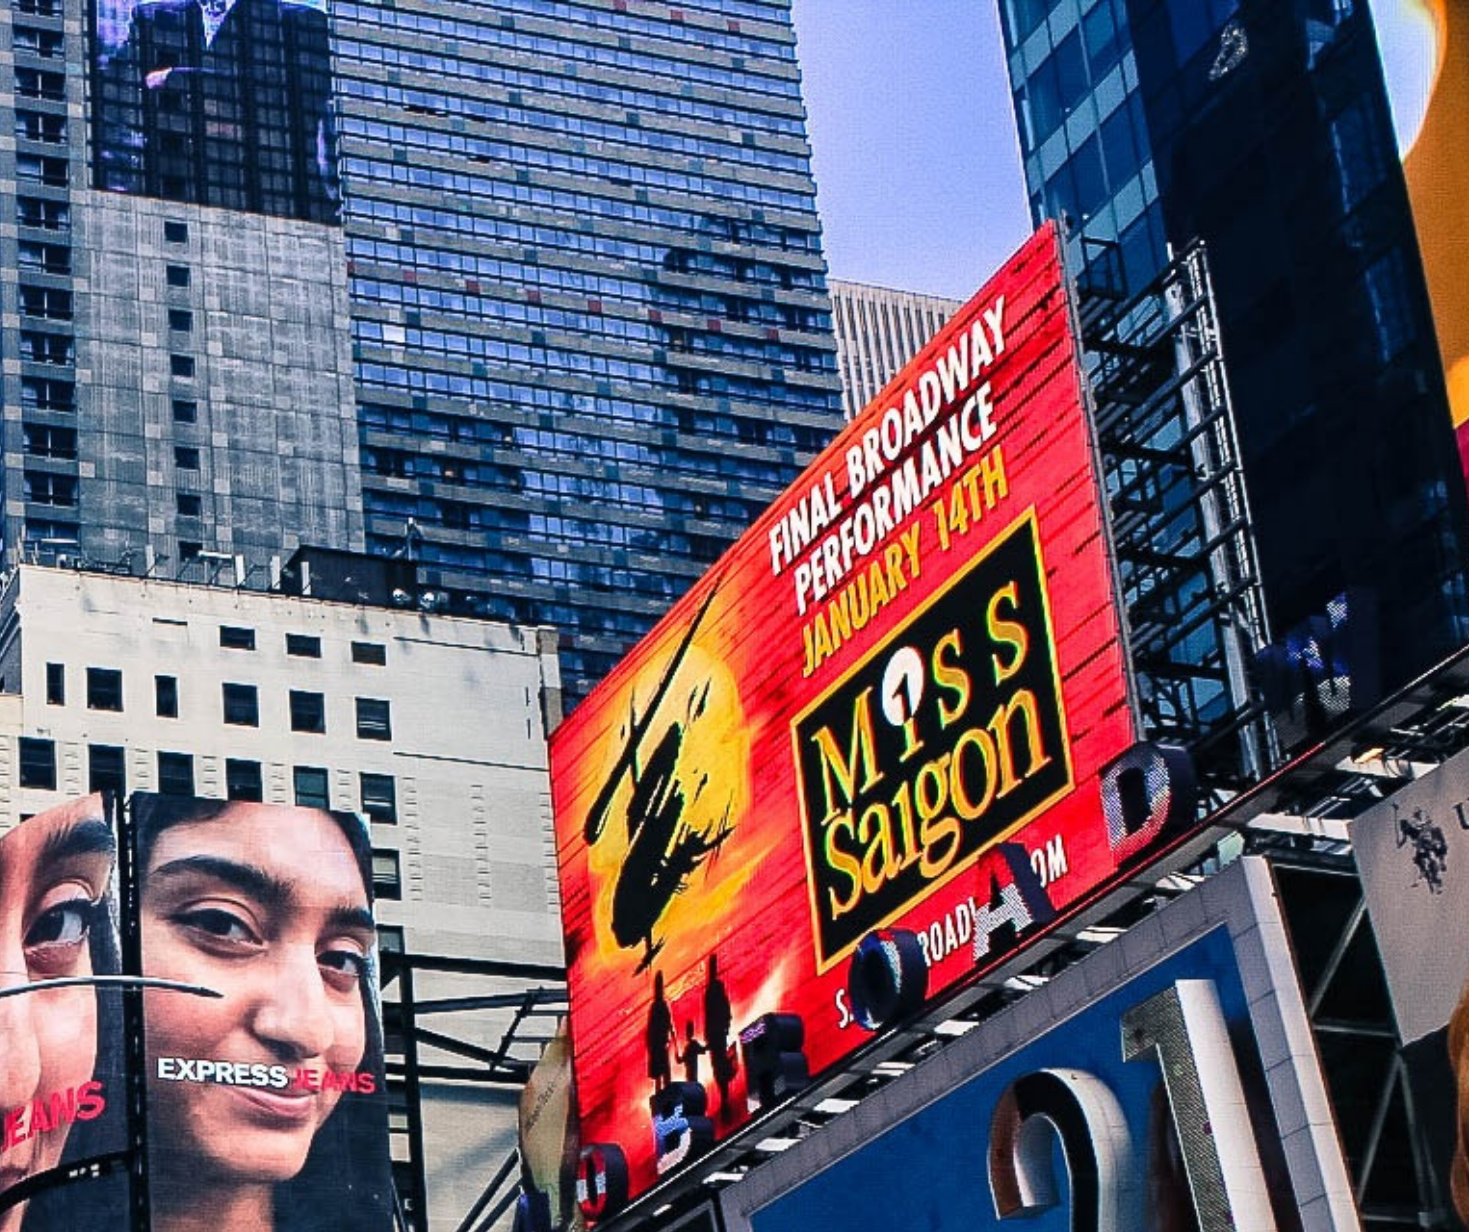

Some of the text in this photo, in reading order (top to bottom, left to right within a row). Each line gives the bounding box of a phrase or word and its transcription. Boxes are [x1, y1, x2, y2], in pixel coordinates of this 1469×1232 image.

[768, 294, 1007, 576] FINAL BROADWAY
[793, 381, 998, 617] PERFORMANCE
[801, 444, 1009, 679] JANUARY 14TH
[825, 686, 1053, 921] Saigon
[156, 1057, 376, 1095] EXPRESS JEANS
